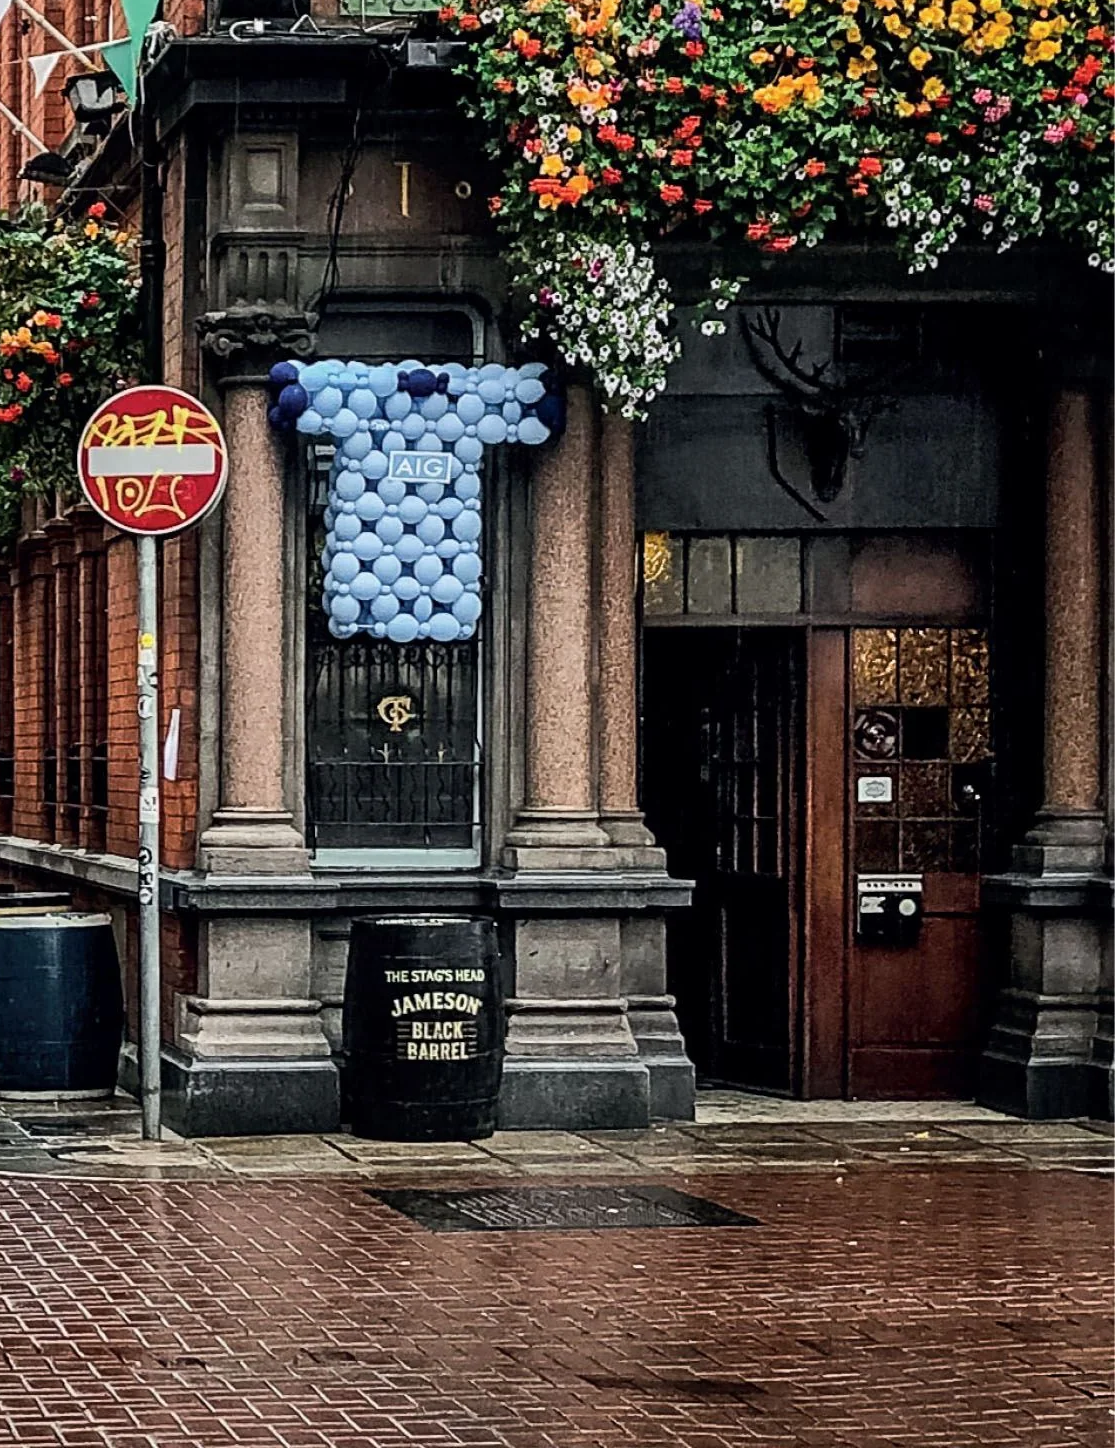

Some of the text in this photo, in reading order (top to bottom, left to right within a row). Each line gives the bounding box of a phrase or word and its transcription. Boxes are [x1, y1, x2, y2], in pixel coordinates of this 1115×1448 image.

[395, 458, 444, 477] AIG
[385, 969, 485, 983] THE STAG'S HEAD
[391, 992, 479, 1017] JAMESON
[412, 1022, 463, 1040] BLACK
[407, 1042, 469, 1061] BARREL
